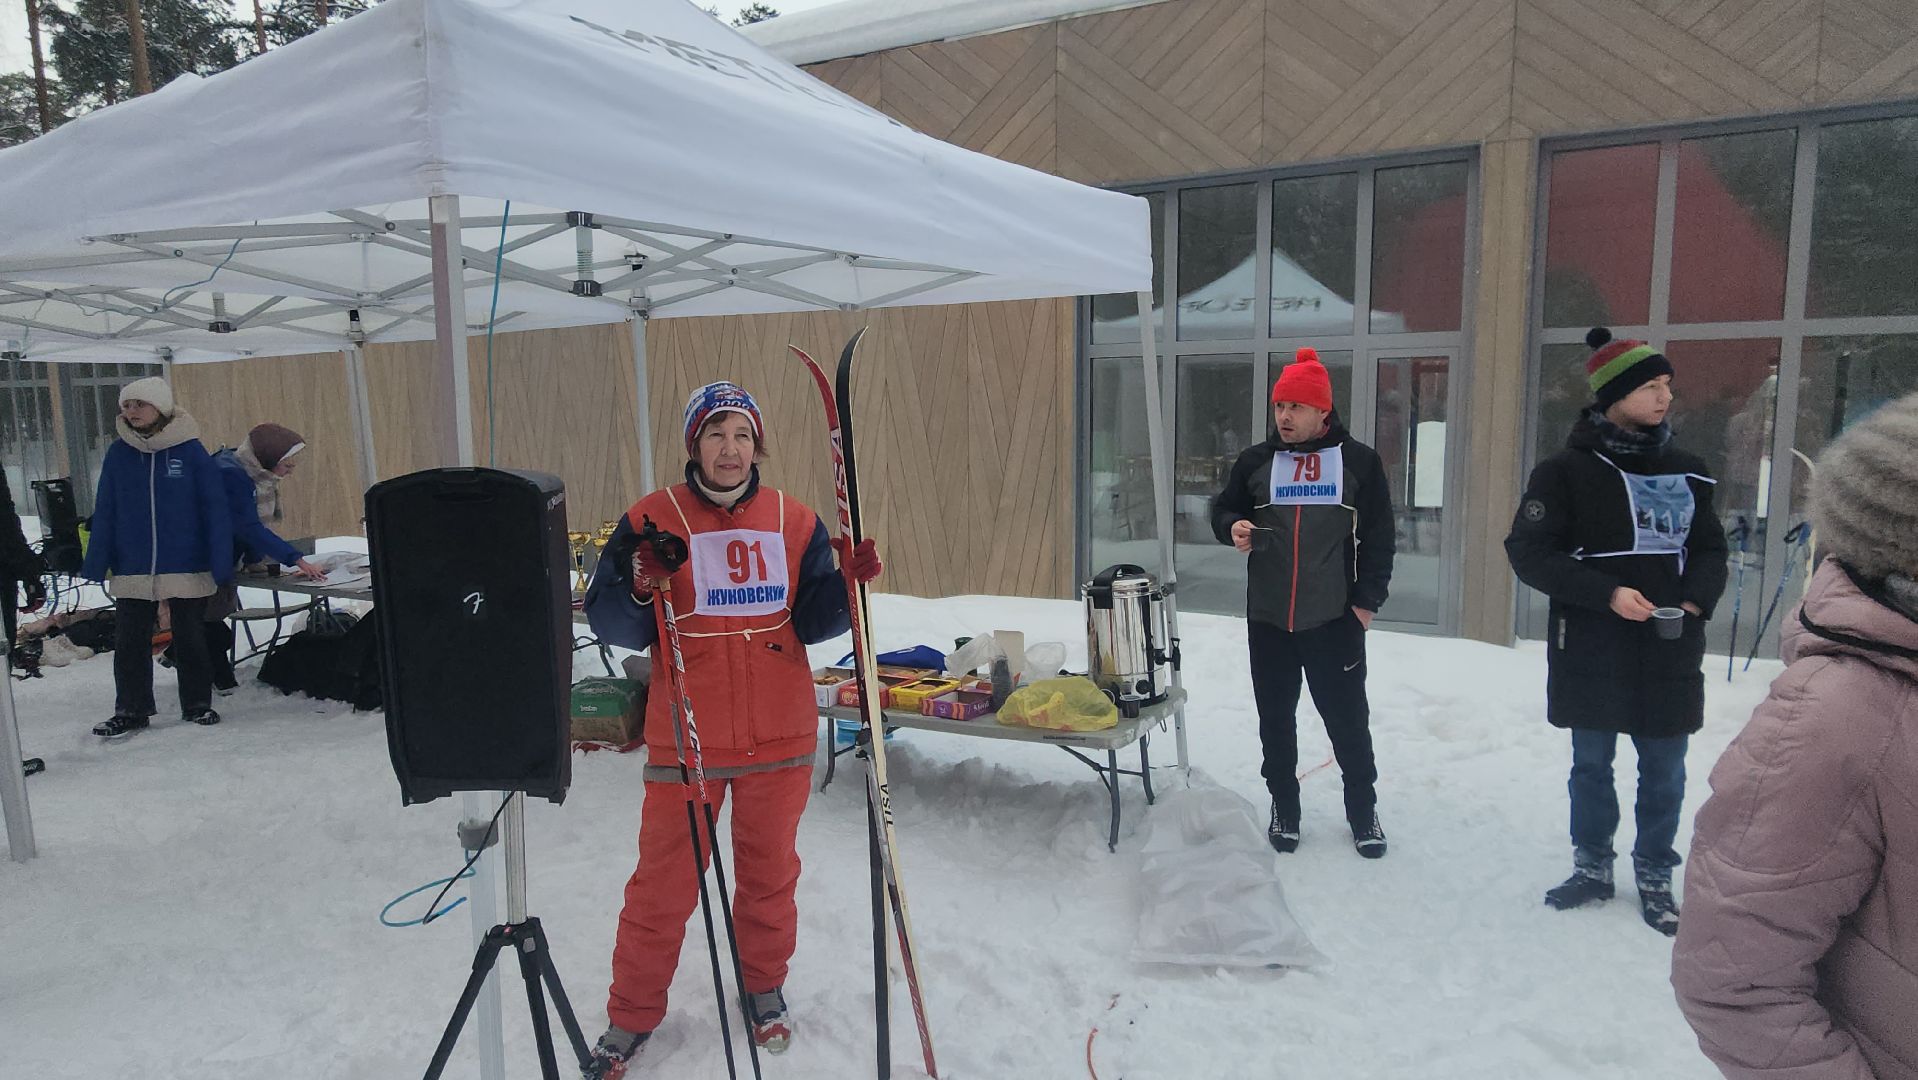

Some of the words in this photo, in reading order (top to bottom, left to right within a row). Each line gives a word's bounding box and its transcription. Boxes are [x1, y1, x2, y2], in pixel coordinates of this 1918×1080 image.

[1293, 453, 1321, 482] 79
[1275, 483, 1337, 498] ЖУКОВСКИЙ
[726, 539, 768, 584] 91
[707, 583, 786, 606] ЖУКОВСКИЙ
[880, 783, 895, 827] TISA
